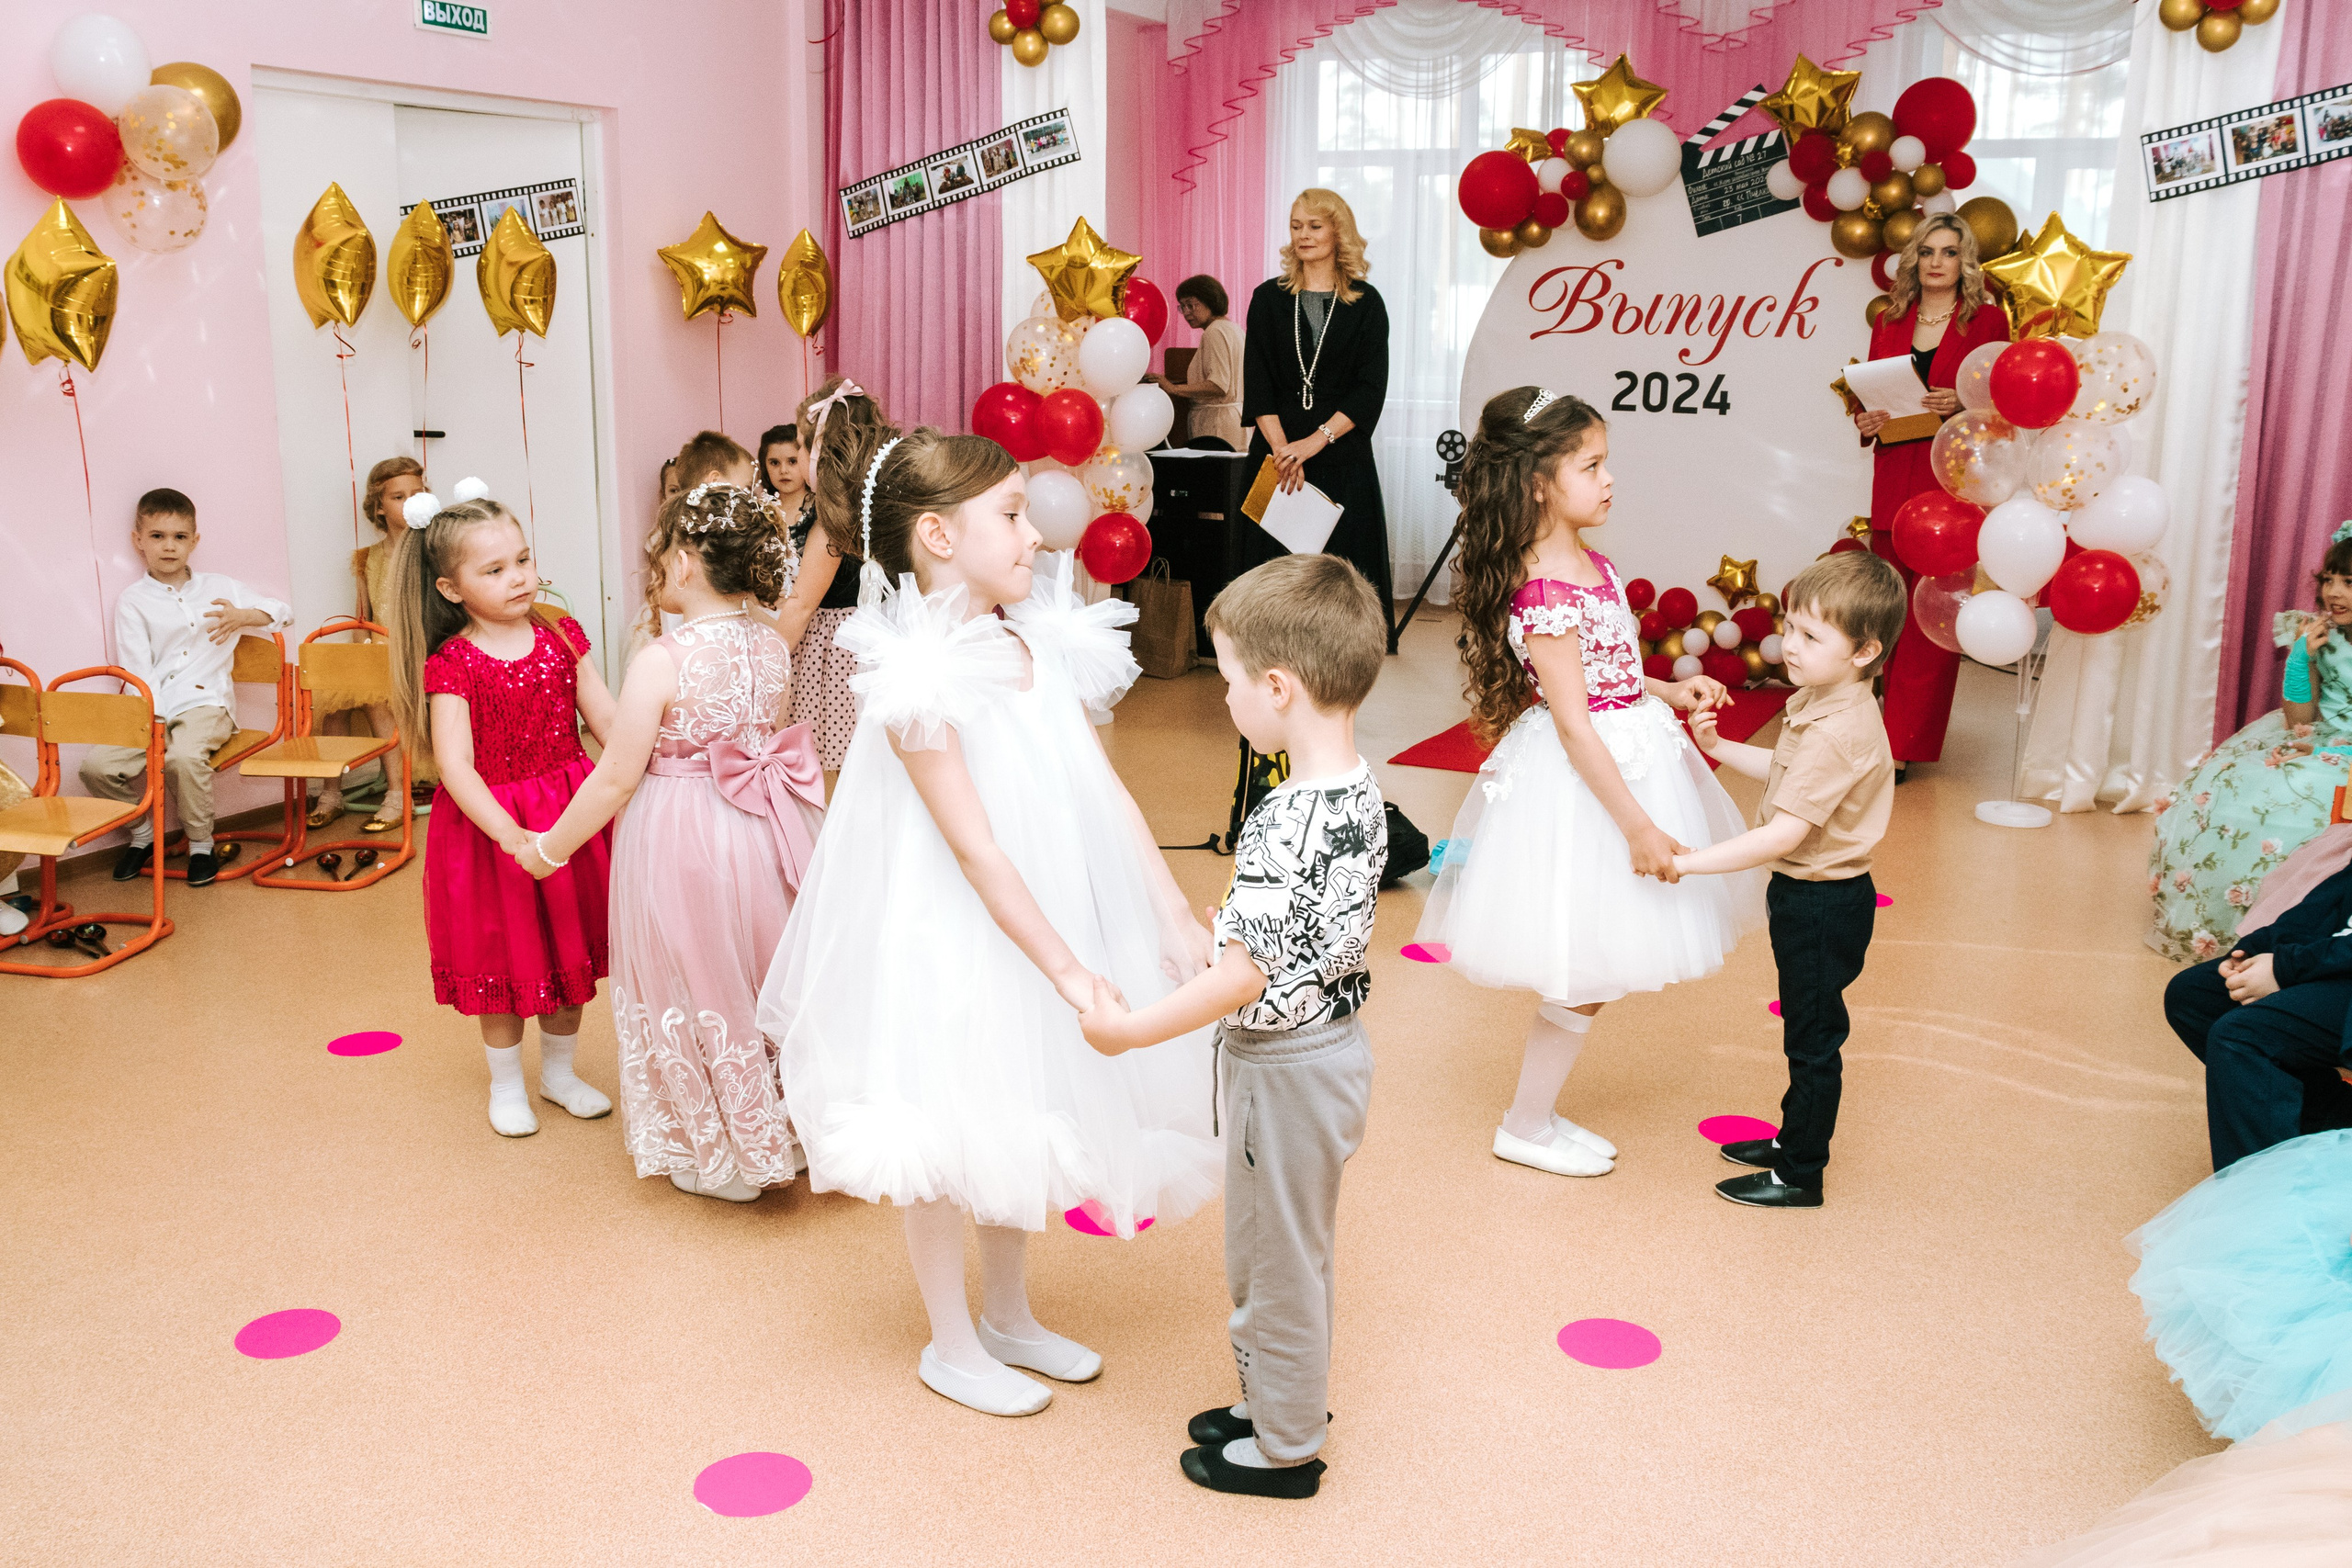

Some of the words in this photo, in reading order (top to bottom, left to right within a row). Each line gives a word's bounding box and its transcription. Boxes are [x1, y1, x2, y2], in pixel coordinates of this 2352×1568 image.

[424, 1, 485, 31] ВЫХОД
[1734, 155, 1746, 166] сад
[1757, 150, 1767, 161] 27
[1724, 186, 1734, 194] 23
[1528, 257, 1844, 366] Выпуск
[1611, 370, 1731, 415] 2024
